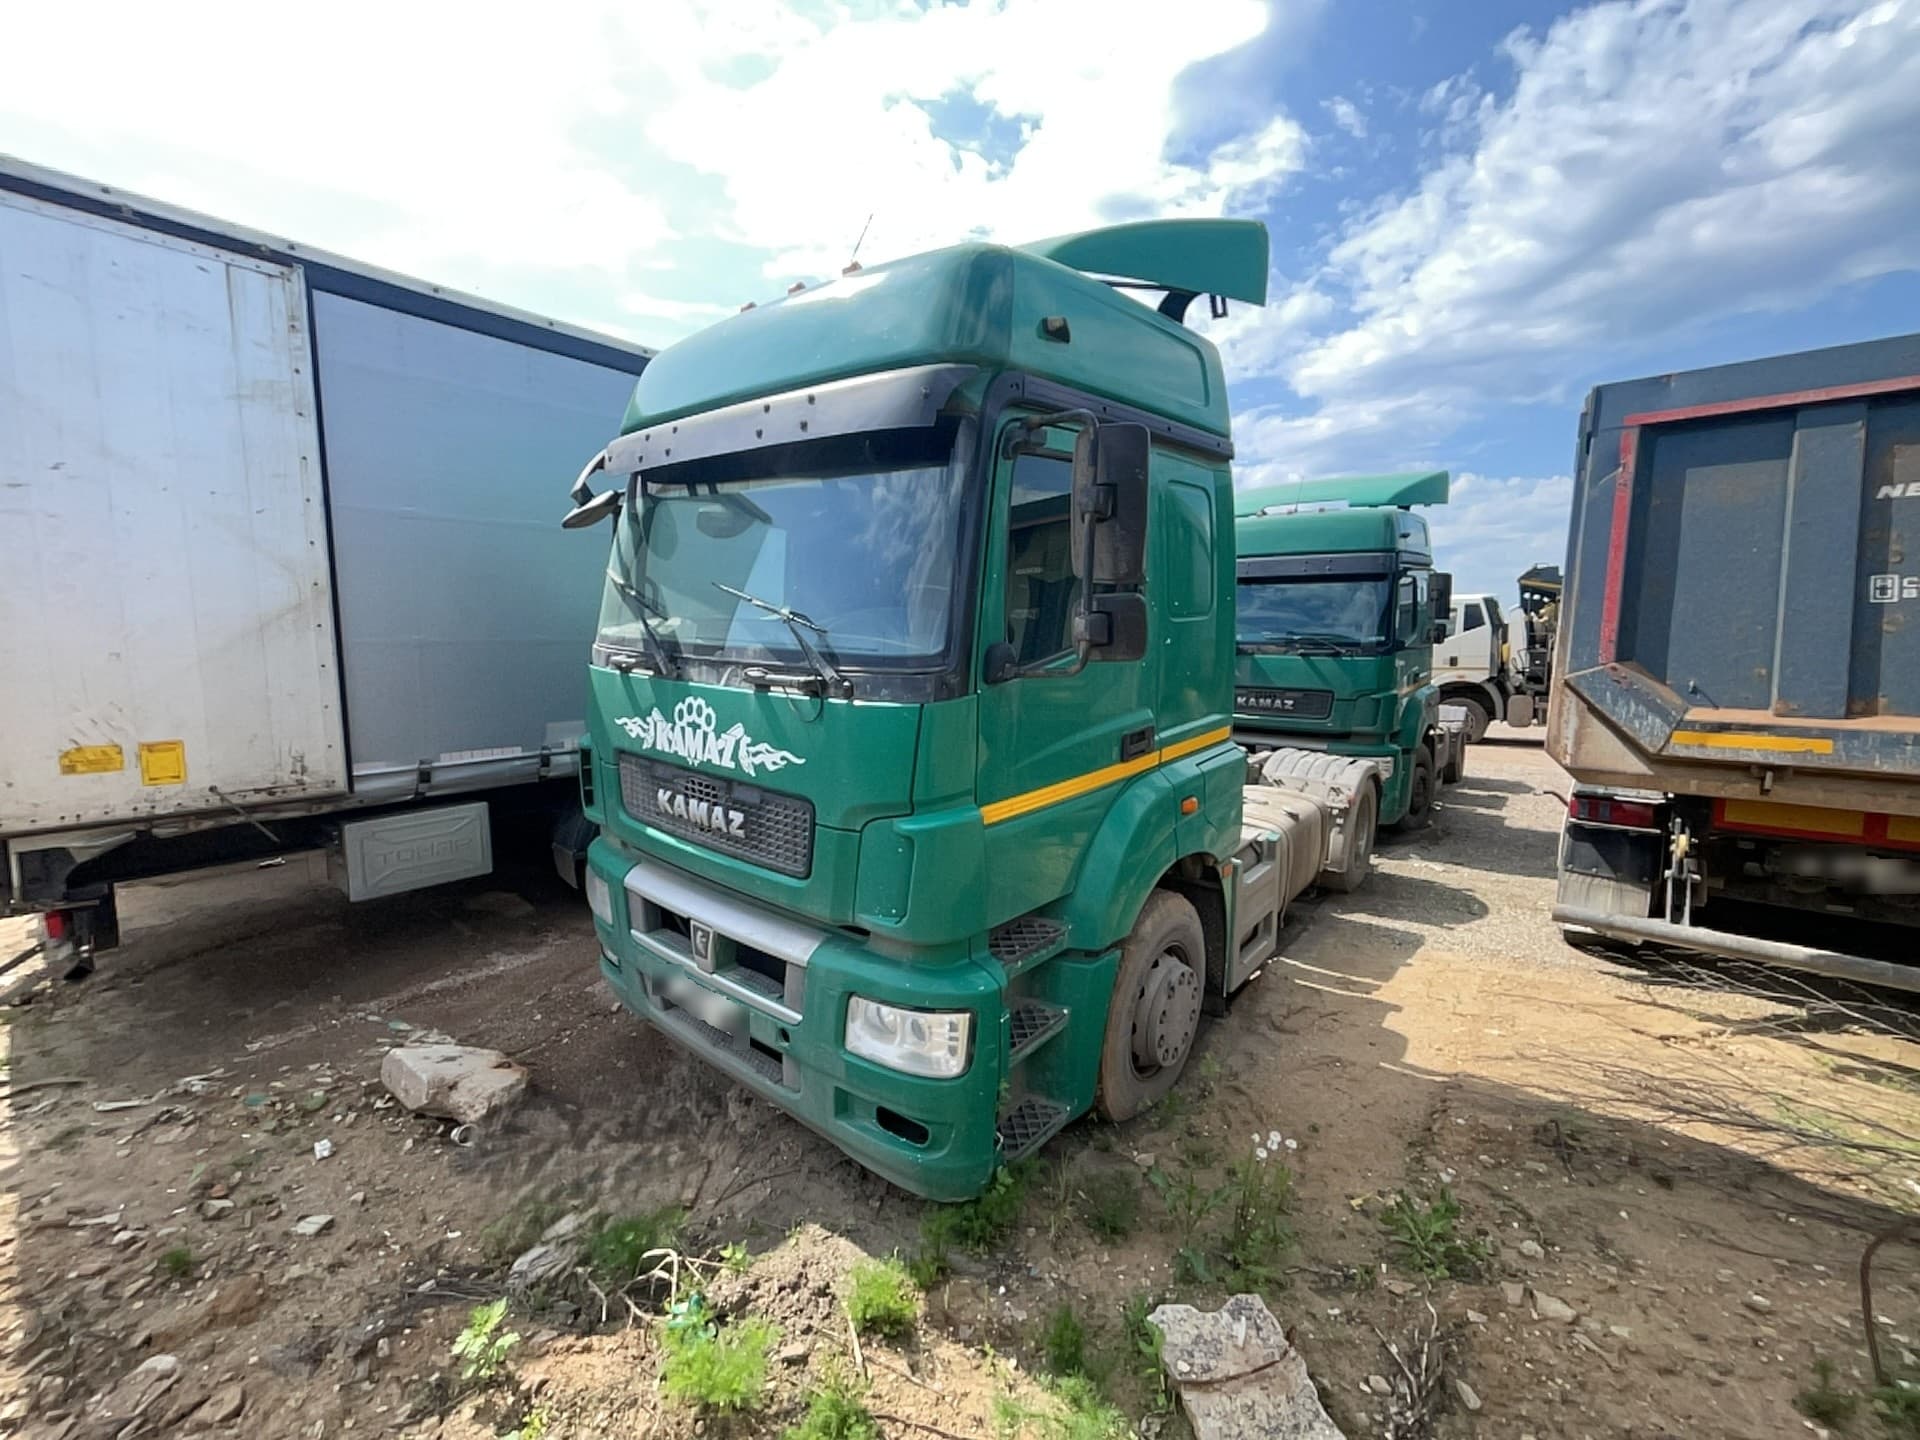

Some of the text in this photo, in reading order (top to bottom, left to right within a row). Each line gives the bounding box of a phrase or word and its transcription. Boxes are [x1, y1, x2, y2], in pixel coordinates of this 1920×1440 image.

[1236, 695, 1295, 711] KAMAZ
[654, 715, 739, 769] KAMAZ
[656, 787, 746, 839] KAMAZ
